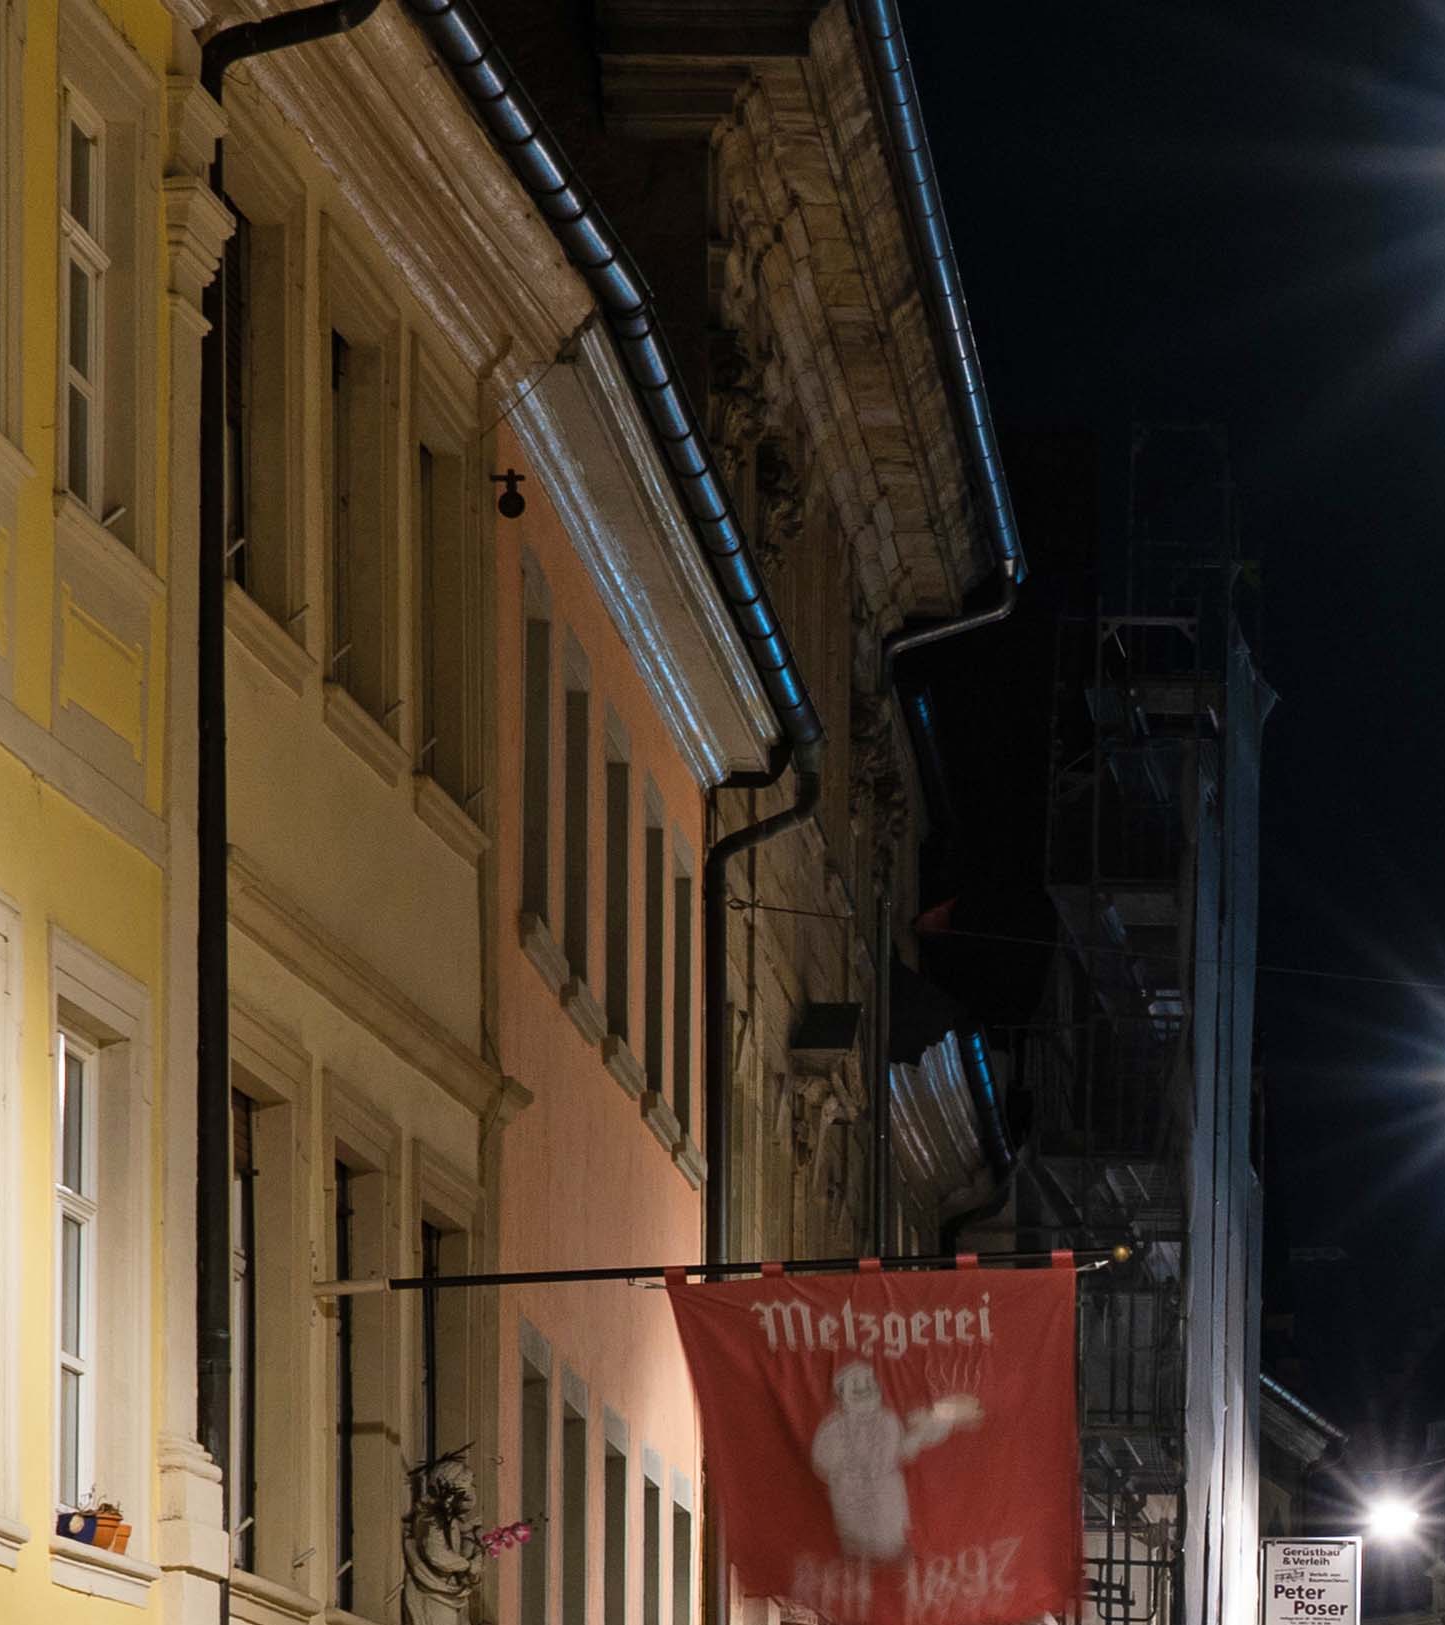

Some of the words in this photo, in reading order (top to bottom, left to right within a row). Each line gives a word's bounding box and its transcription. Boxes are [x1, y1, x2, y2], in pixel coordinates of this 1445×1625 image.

[750, 1291, 994, 1361] Metzgerei
[1282, 1547, 1340, 1557] Gerüstbau
[1282, 1557, 1290, 1566] &
[1293, 1557, 1331, 1566] Verleih
[1274, 1584, 1326, 1599] Peter
[1294, 1601, 1349, 1616] Poser
